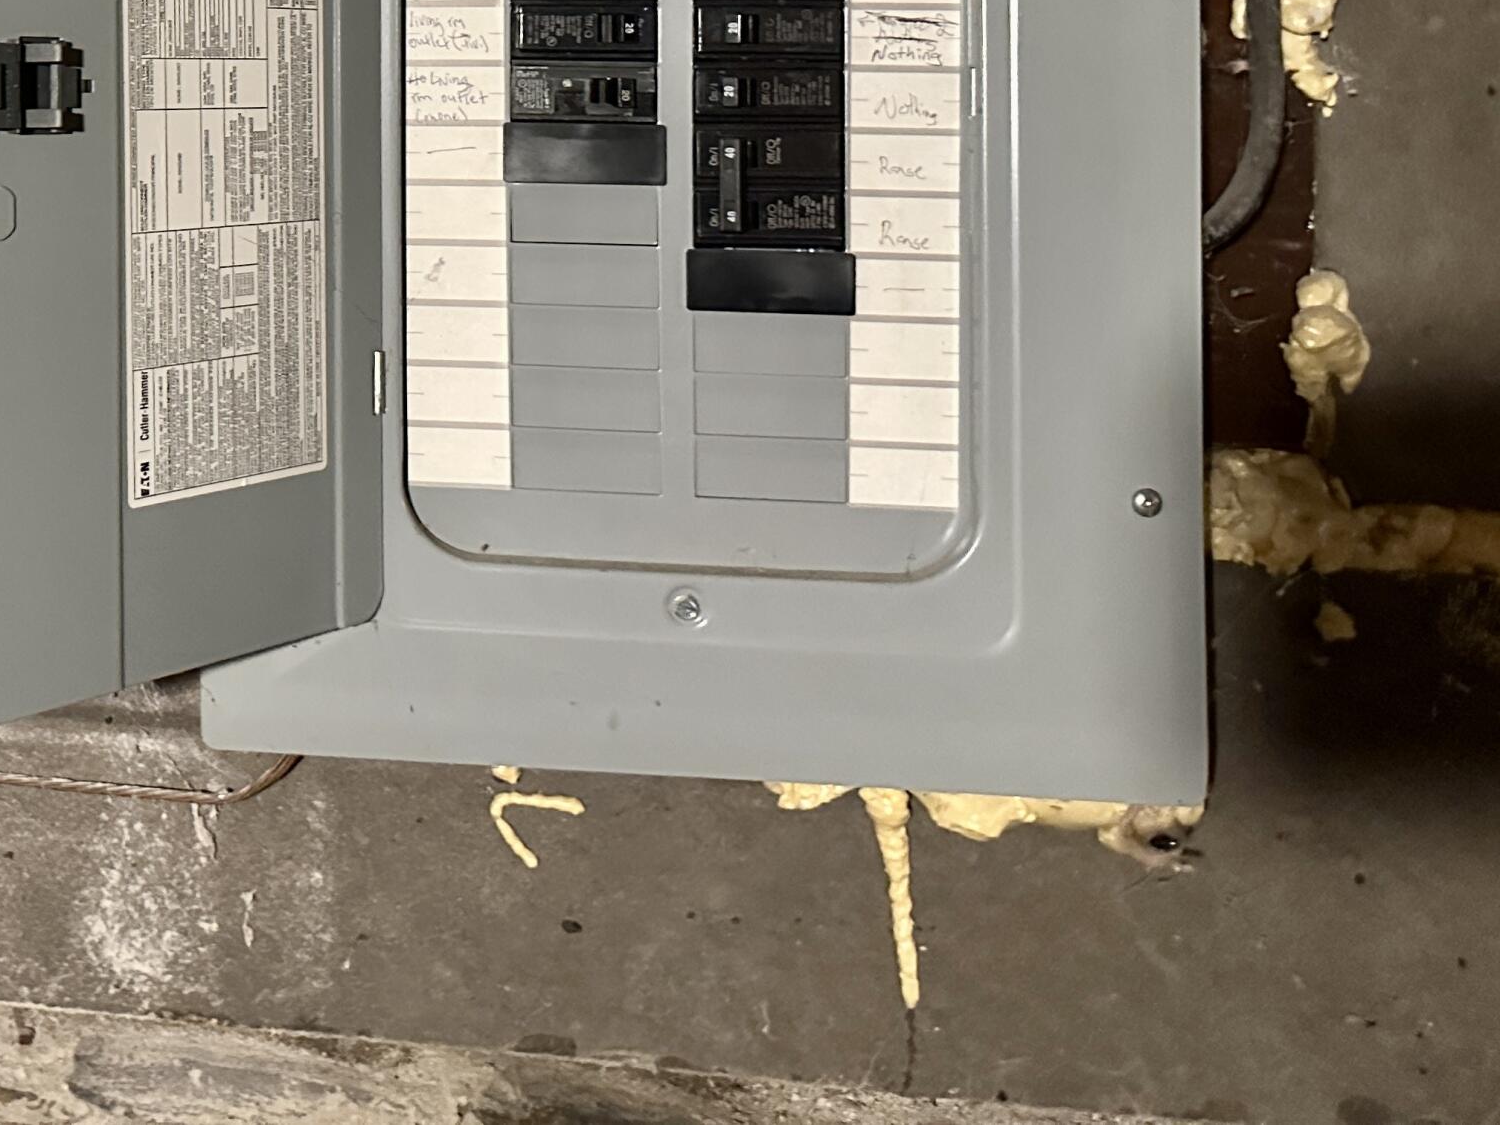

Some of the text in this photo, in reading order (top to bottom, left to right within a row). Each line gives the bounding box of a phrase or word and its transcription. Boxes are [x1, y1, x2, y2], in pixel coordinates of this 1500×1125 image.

[624, 22, 635, 34] 20
[727, 22, 739, 34] 20
[871, 45, 943, 67] Nothing
[621, 89, 631, 102] 20
[723, 85, 735, 98] 20
[873, 92, 938, 126] Nothing
[724, 146, 736, 159] 40
[726, 210, 737, 223] 40
[140, 371, 149, 441] Cutler-Hammer
